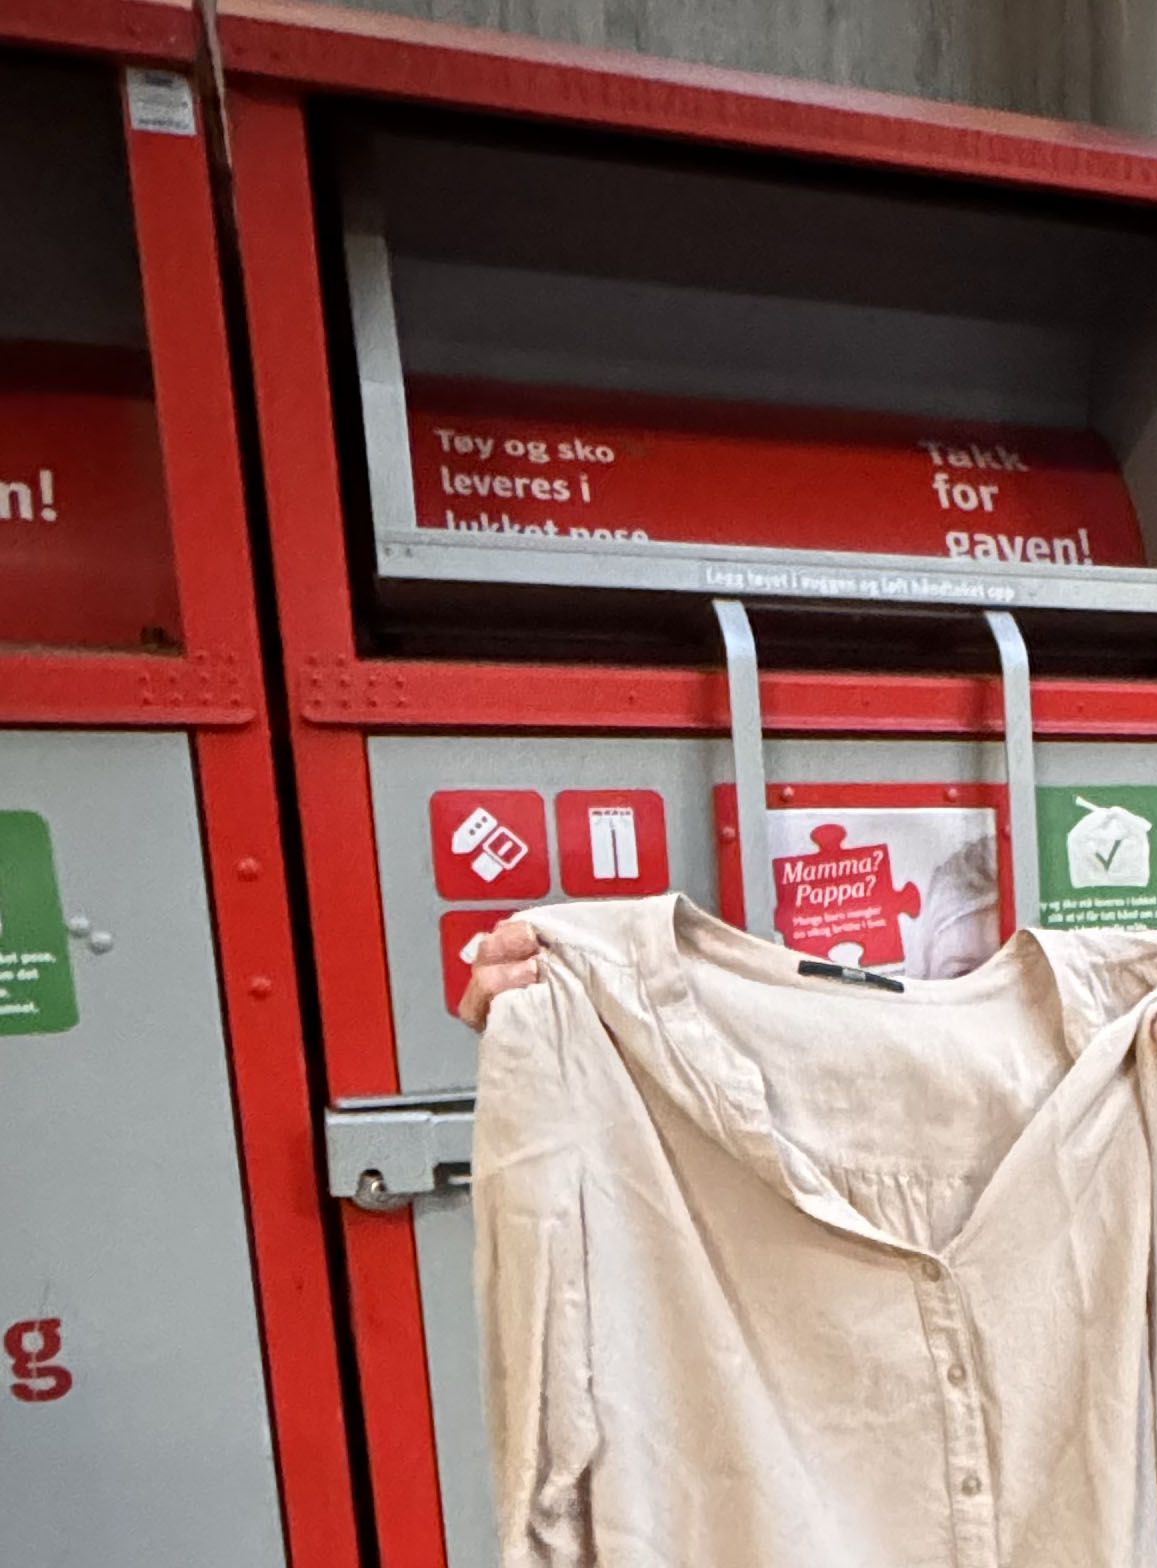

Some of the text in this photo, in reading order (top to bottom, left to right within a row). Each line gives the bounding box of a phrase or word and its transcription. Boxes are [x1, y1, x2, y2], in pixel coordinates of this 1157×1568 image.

[434, 428, 615, 464] Tøy og sko
[441, 465, 590, 504] leveres i
[932, 472, 999, 512] for
[782, 850, 884, 885] Mamma?
[795, 875, 877, 907] Pappa?
[4, 1317, 72, 1402] g
